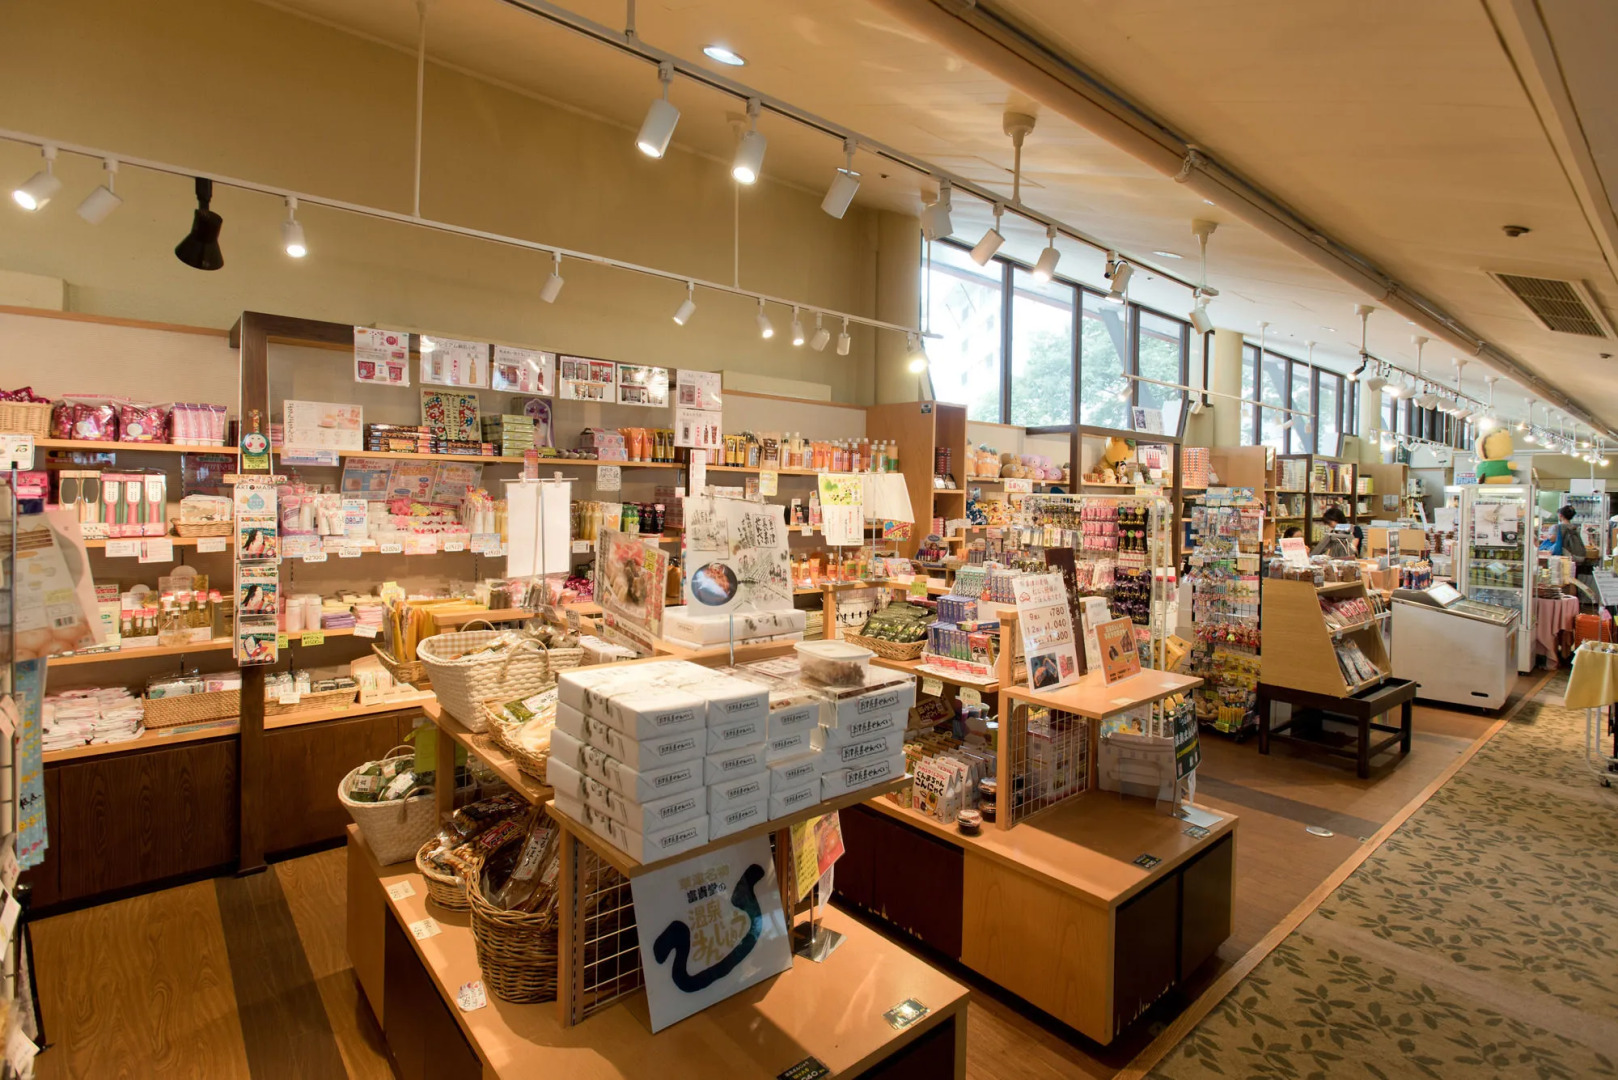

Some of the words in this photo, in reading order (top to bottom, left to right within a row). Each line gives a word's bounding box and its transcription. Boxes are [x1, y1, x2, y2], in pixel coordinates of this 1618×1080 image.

[914, 776, 944, 797] こんにゃく
[688, 898, 723, 931] 温泉
